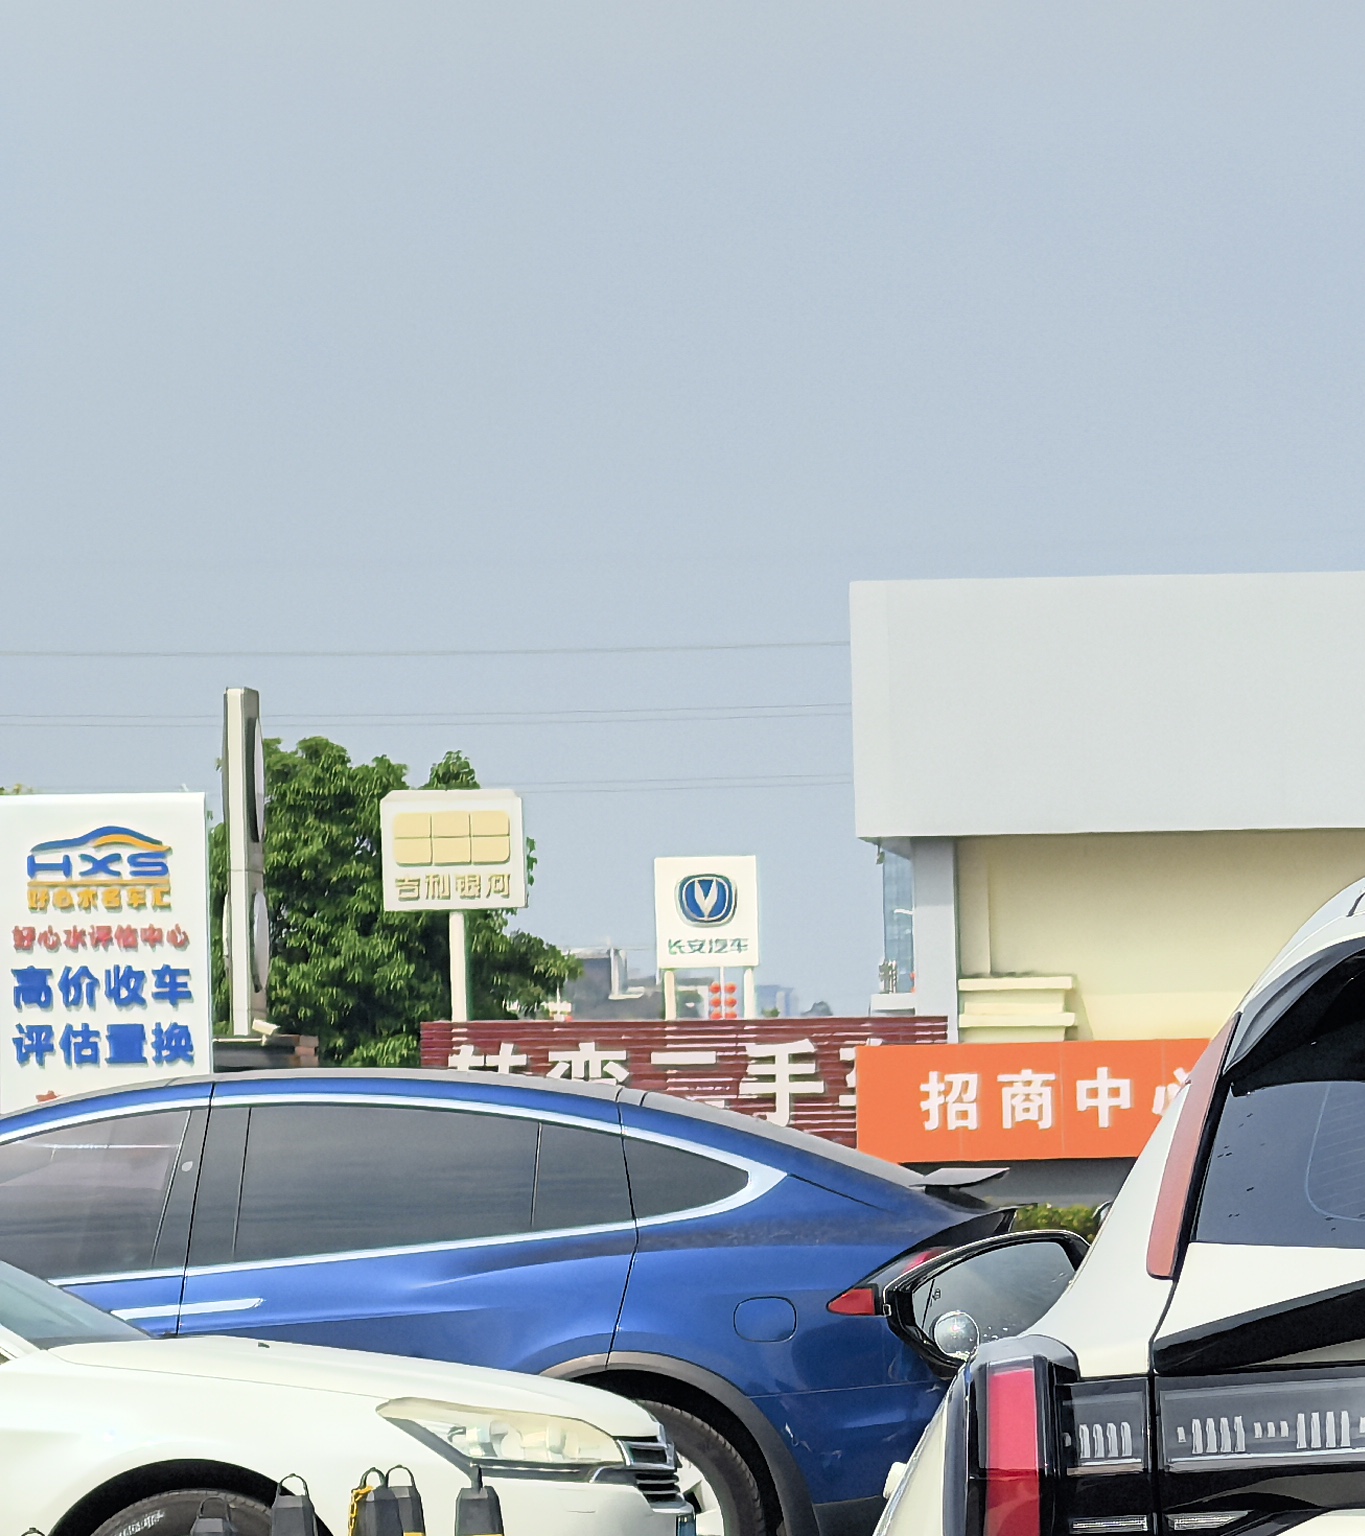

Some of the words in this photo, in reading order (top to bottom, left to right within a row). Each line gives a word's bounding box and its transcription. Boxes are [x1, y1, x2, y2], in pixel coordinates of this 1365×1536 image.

[27, 852, 169, 878] HXS
[395, 873, 511, 900] 吉利银河
[667, 938, 750, 956] 长安汽车
[11, 964, 194, 1010] 高价收车
[11, 1021, 194, 1067] 评估置换
